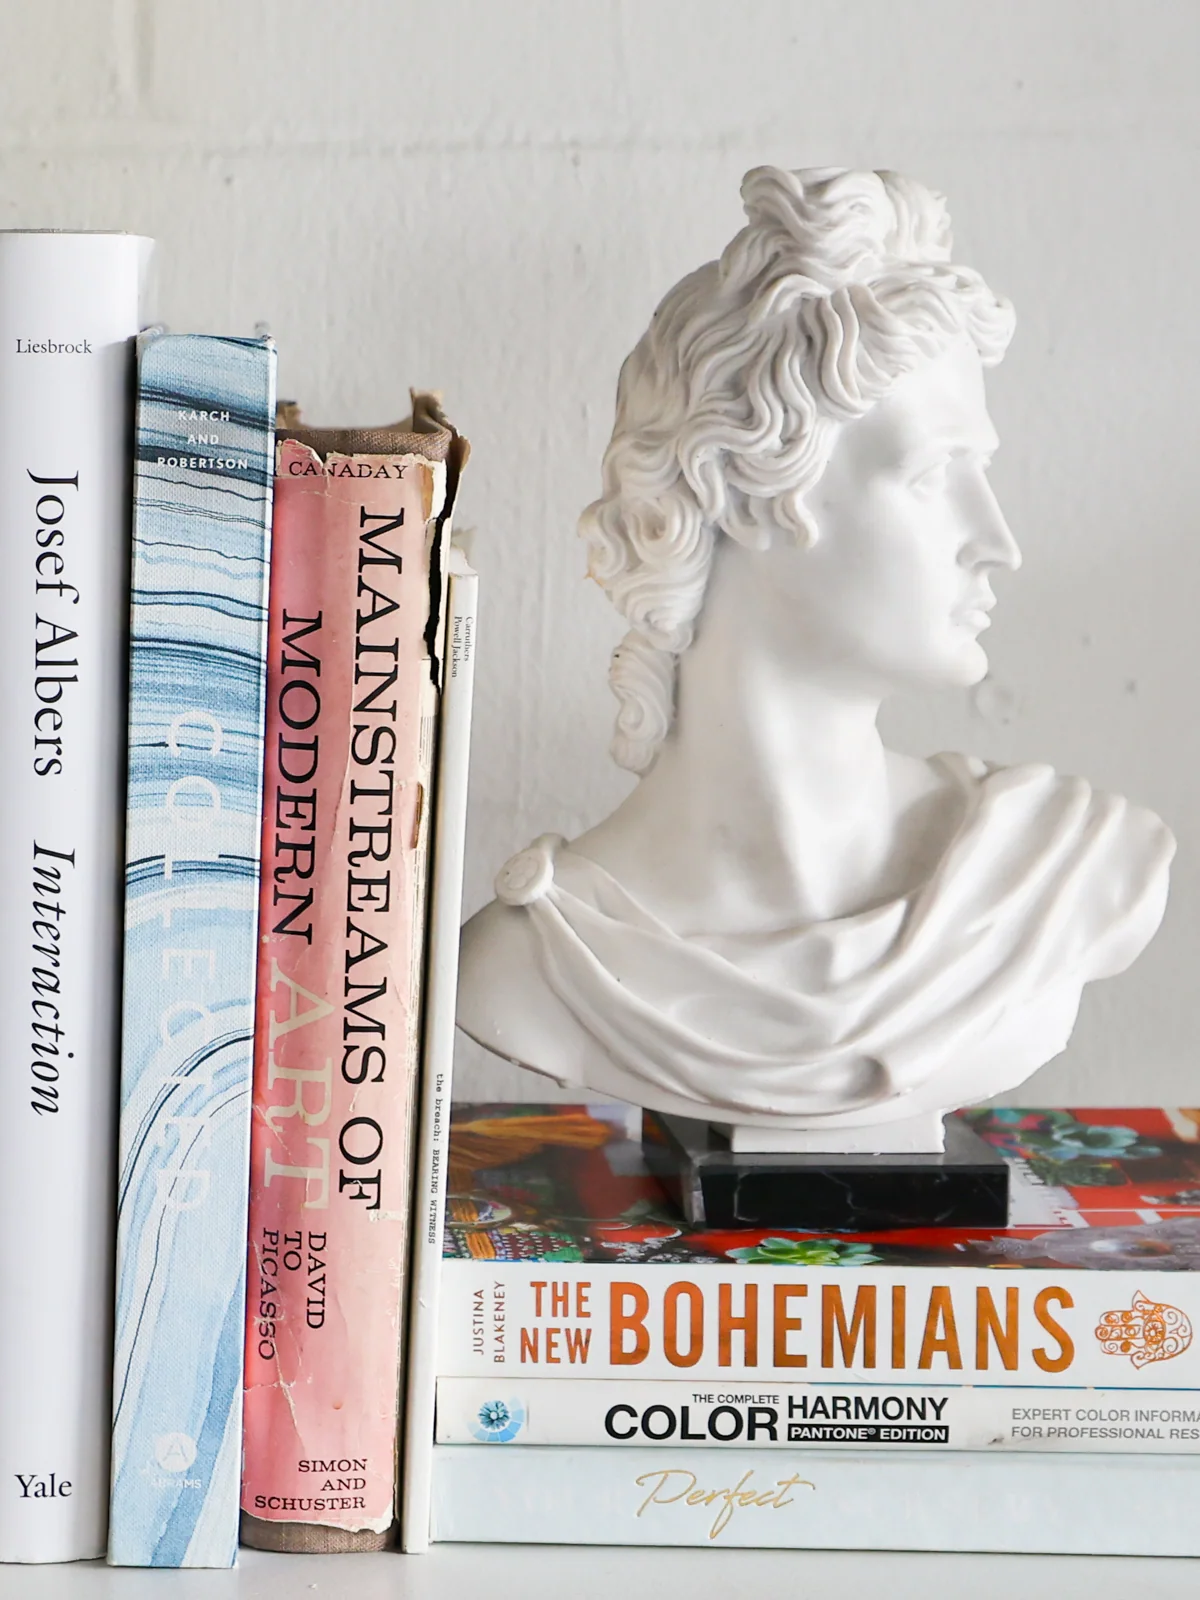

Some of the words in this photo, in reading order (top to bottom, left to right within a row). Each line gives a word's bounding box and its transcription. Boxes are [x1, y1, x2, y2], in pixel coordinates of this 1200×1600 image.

[16, 338, 92, 354] Liesbrock
[178, 410, 230, 421] KARCH
[187, 434, 219, 444] AND
[157, 457, 248, 469] ROBERTSON
[289, 461, 408, 479] CANADAY
[28, 468, 80, 605] Josef
[452, 616, 462, 645] Powell
[464, 616, 473, 661] Carruthers
[451, 645, 461, 677] Jackson
[33, 613, 79, 776] Albers
[271, 608, 323, 944] MODERN
[340, 506, 405, 1085] MAINSTREAMS
[30, 839, 75, 1117] Interaction
[263, 957, 335, 1210] ART
[436, 1073, 444, 1092] the
[433, 1099, 442, 1141] breach:
[338, 1118, 383, 1211] OF
[430, 1149, 439, 1193] BEARING
[428, 1200, 437, 1244] WITNESS
[284, 1231, 303, 1271] TO
[258, 1227, 280, 1361] PICASSO
[305, 1230, 327, 1329] DAVID
[530, 1281, 591, 1319] THE
[472, 1289, 484, 1356] JUSTINA
[493, 1280, 505, 1363] BLAKENEY
[609, 1281, 1075, 1373] BOHEMIANS
[520, 1328, 591, 1364] NEW
[692, 1394, 714, 1404] THE
[717, 1394, 780, 1404] COMPLETE
[788, 1396, 948, 1420] HARMONY
[1012, 1408, 1071, 1420] EXPERT
[1076, 1409, 1130, 1421] COLOR
[604, 1404, 779, 1441] COLOR
[879, 1428, 946, 1441] EDITION
[1012, 1427, 1042, 1438] FOR
[1048, 1427, 1164, 1439] PROFESSIONAL
[1170, 1429, 1200, 1440] RES
[298, 1458, 367, 1472] SIMON
[15, 1473, 73, 1498] Yale
[255, 1495, 366, 1510] SCHUSTER
[321, 1478, 366, 1491] AND
[636, 1469, 814, 1539] Perfect
